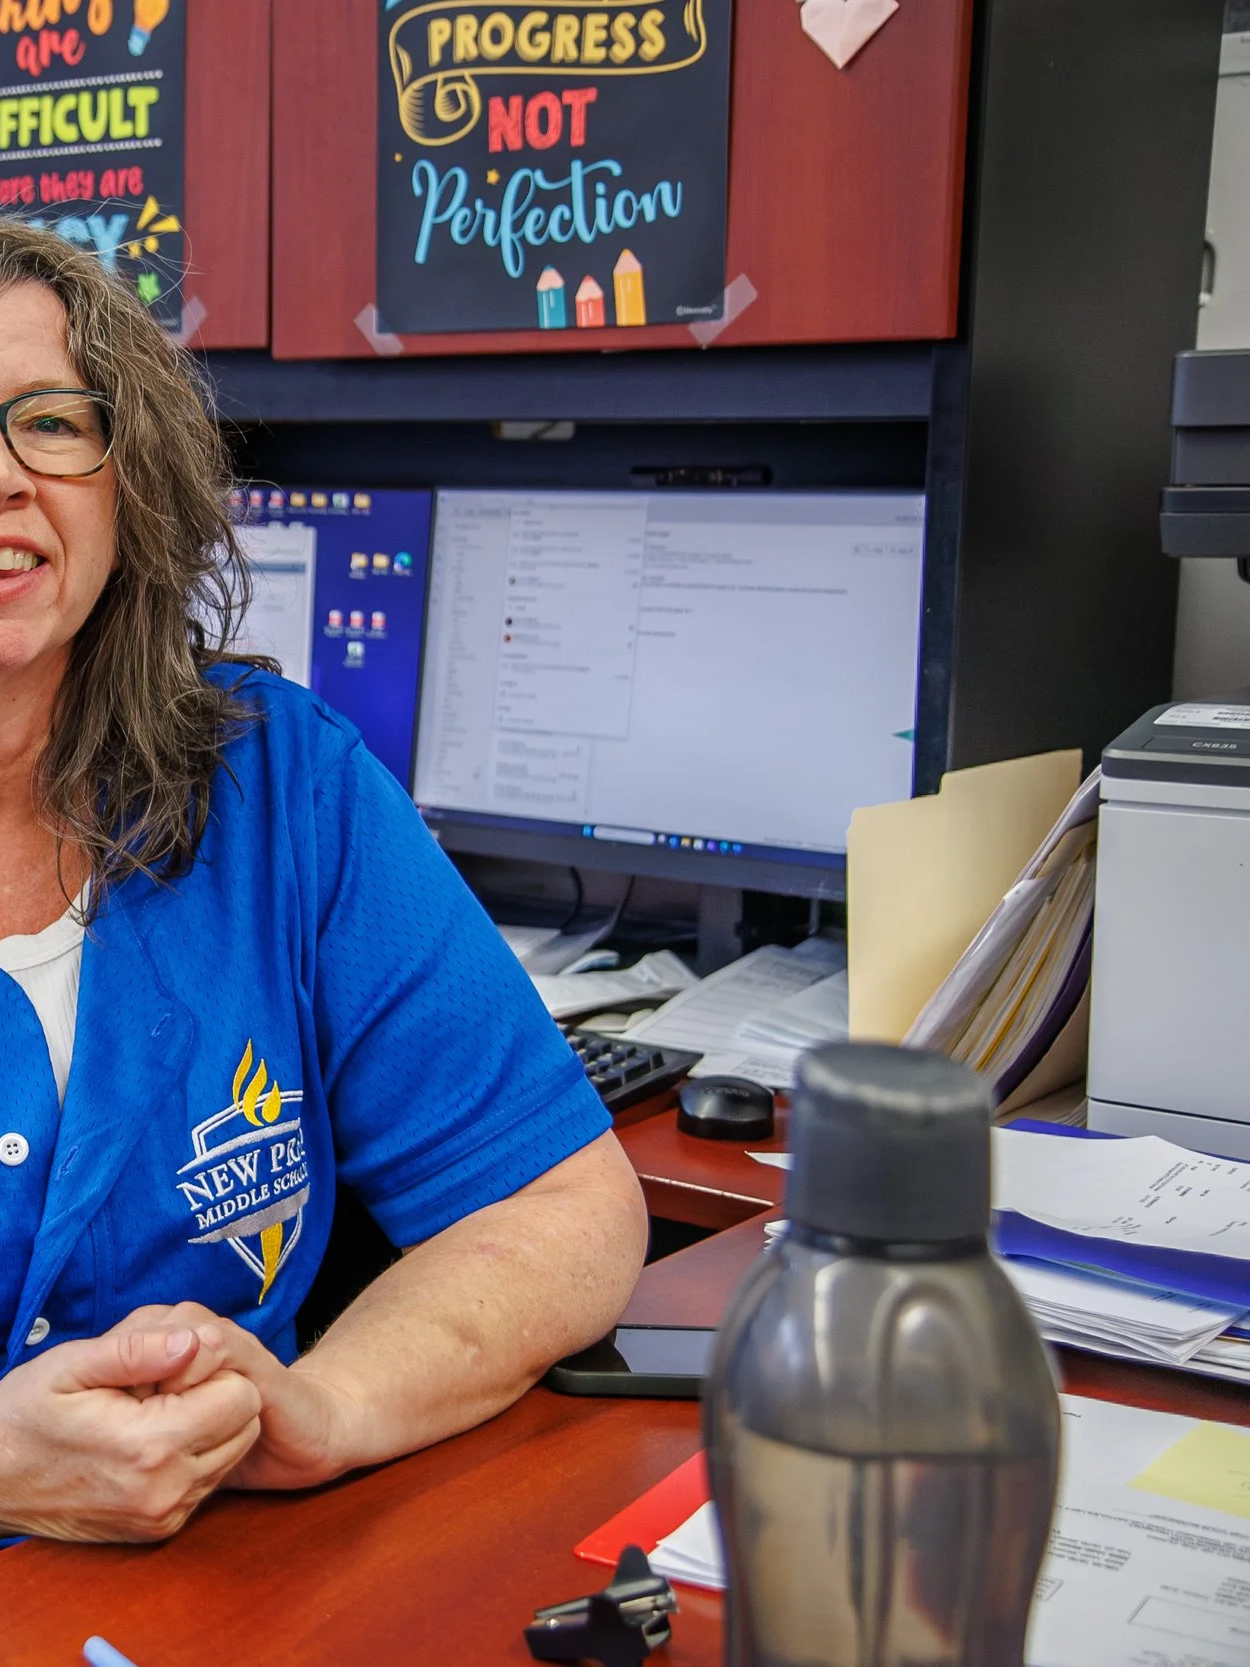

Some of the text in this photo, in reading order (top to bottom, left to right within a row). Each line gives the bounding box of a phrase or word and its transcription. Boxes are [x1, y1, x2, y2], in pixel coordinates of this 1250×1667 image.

[16, 28, 86, 77] are
[427, 9, 666, 67] PROGRESS
[488, 87, 598, 153] NOT
[39, 169, 95, 204] they
[100, 165, 144, 198] are
[412, 159, 682, 278] Perfection
[176, 1149, 261, 1211] NEW
[196, 1183, 270, 1230] MIDDLE
